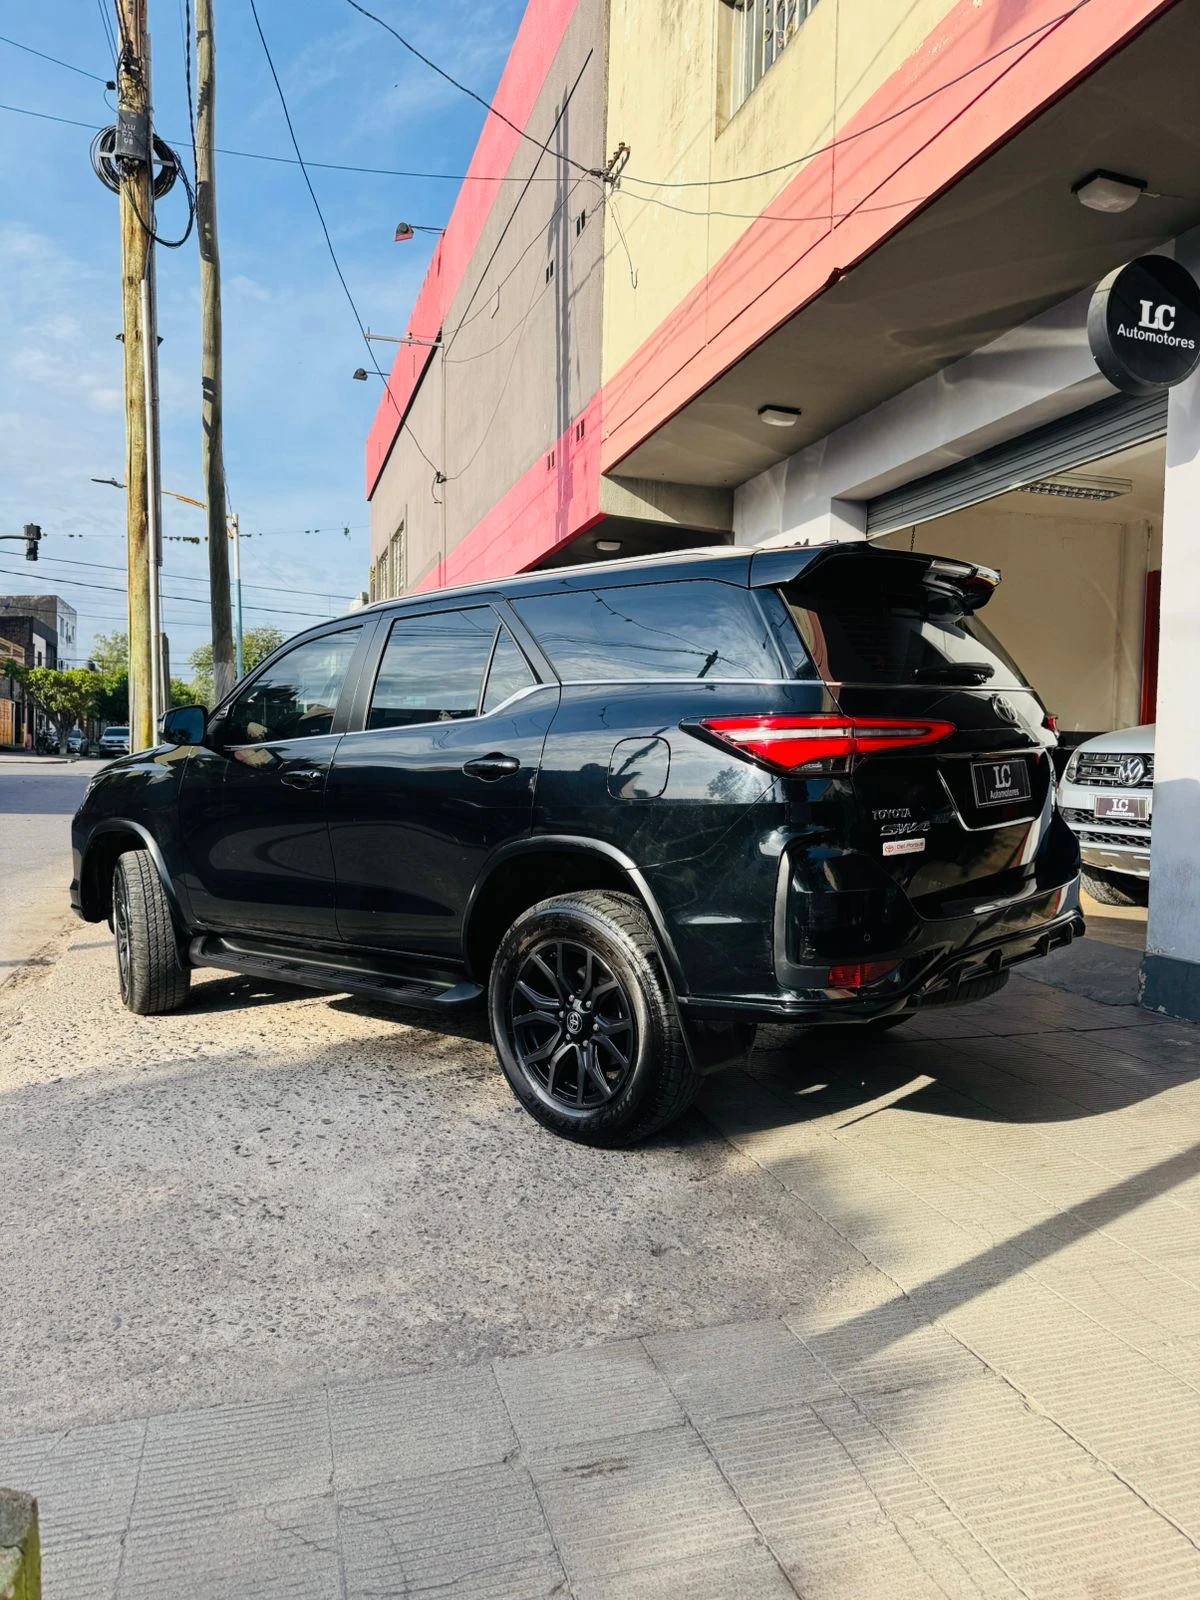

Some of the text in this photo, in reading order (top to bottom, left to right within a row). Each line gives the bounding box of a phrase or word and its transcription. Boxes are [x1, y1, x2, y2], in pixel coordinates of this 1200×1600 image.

[1138, 299, 1176, 332] LC
[1117, 323, 1195, 350] Automotores
[993, 764, 1012, 788] LC
[871, 807, 912, 820] TOYOTA
[1111, 798, 1129, 812] LC
